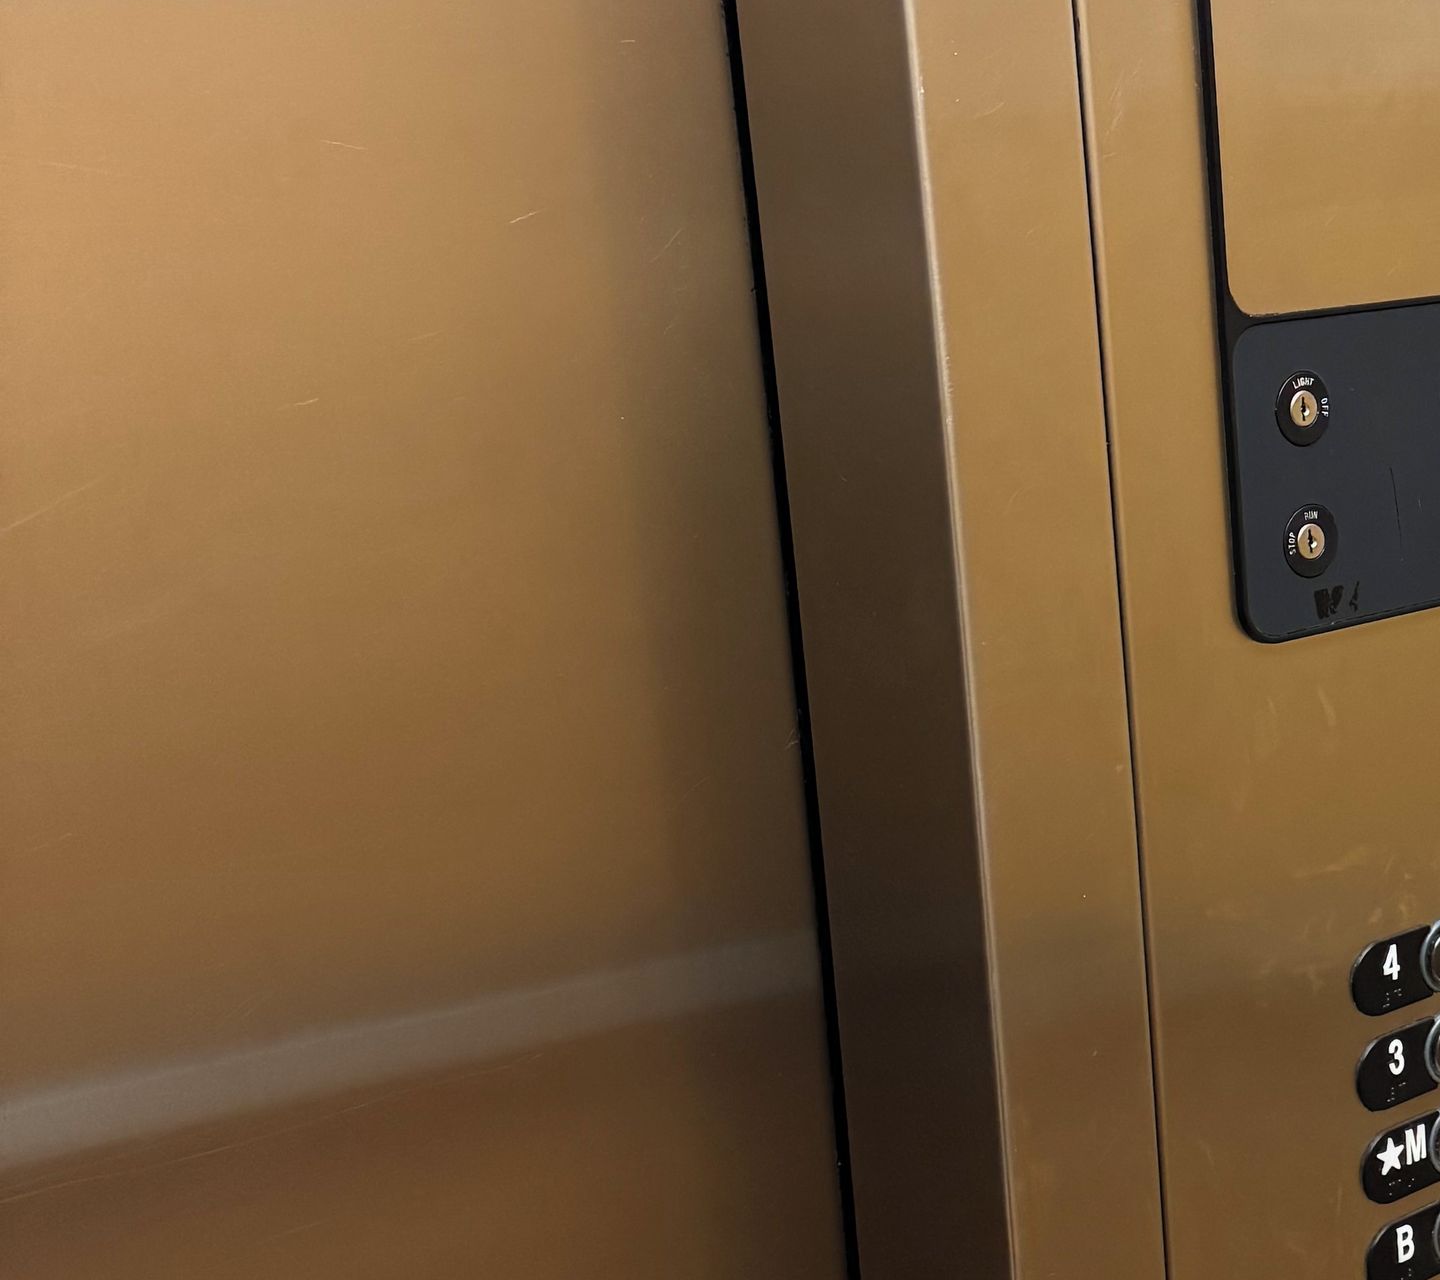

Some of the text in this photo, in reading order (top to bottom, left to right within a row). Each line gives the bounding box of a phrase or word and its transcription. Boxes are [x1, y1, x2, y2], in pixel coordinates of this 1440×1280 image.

[1292, 377, 1315, 390] LIGHT
[1321, 397, 1329, 418] OFF
[1304, 510, 1318, 520] RUN
[1288, 532, 1296, 555] STOP
[1383, 944, 1400, 981] 4
[1388, 1038, 1405, 1076] 3
[1396, 1224, 1415, 1263] B
